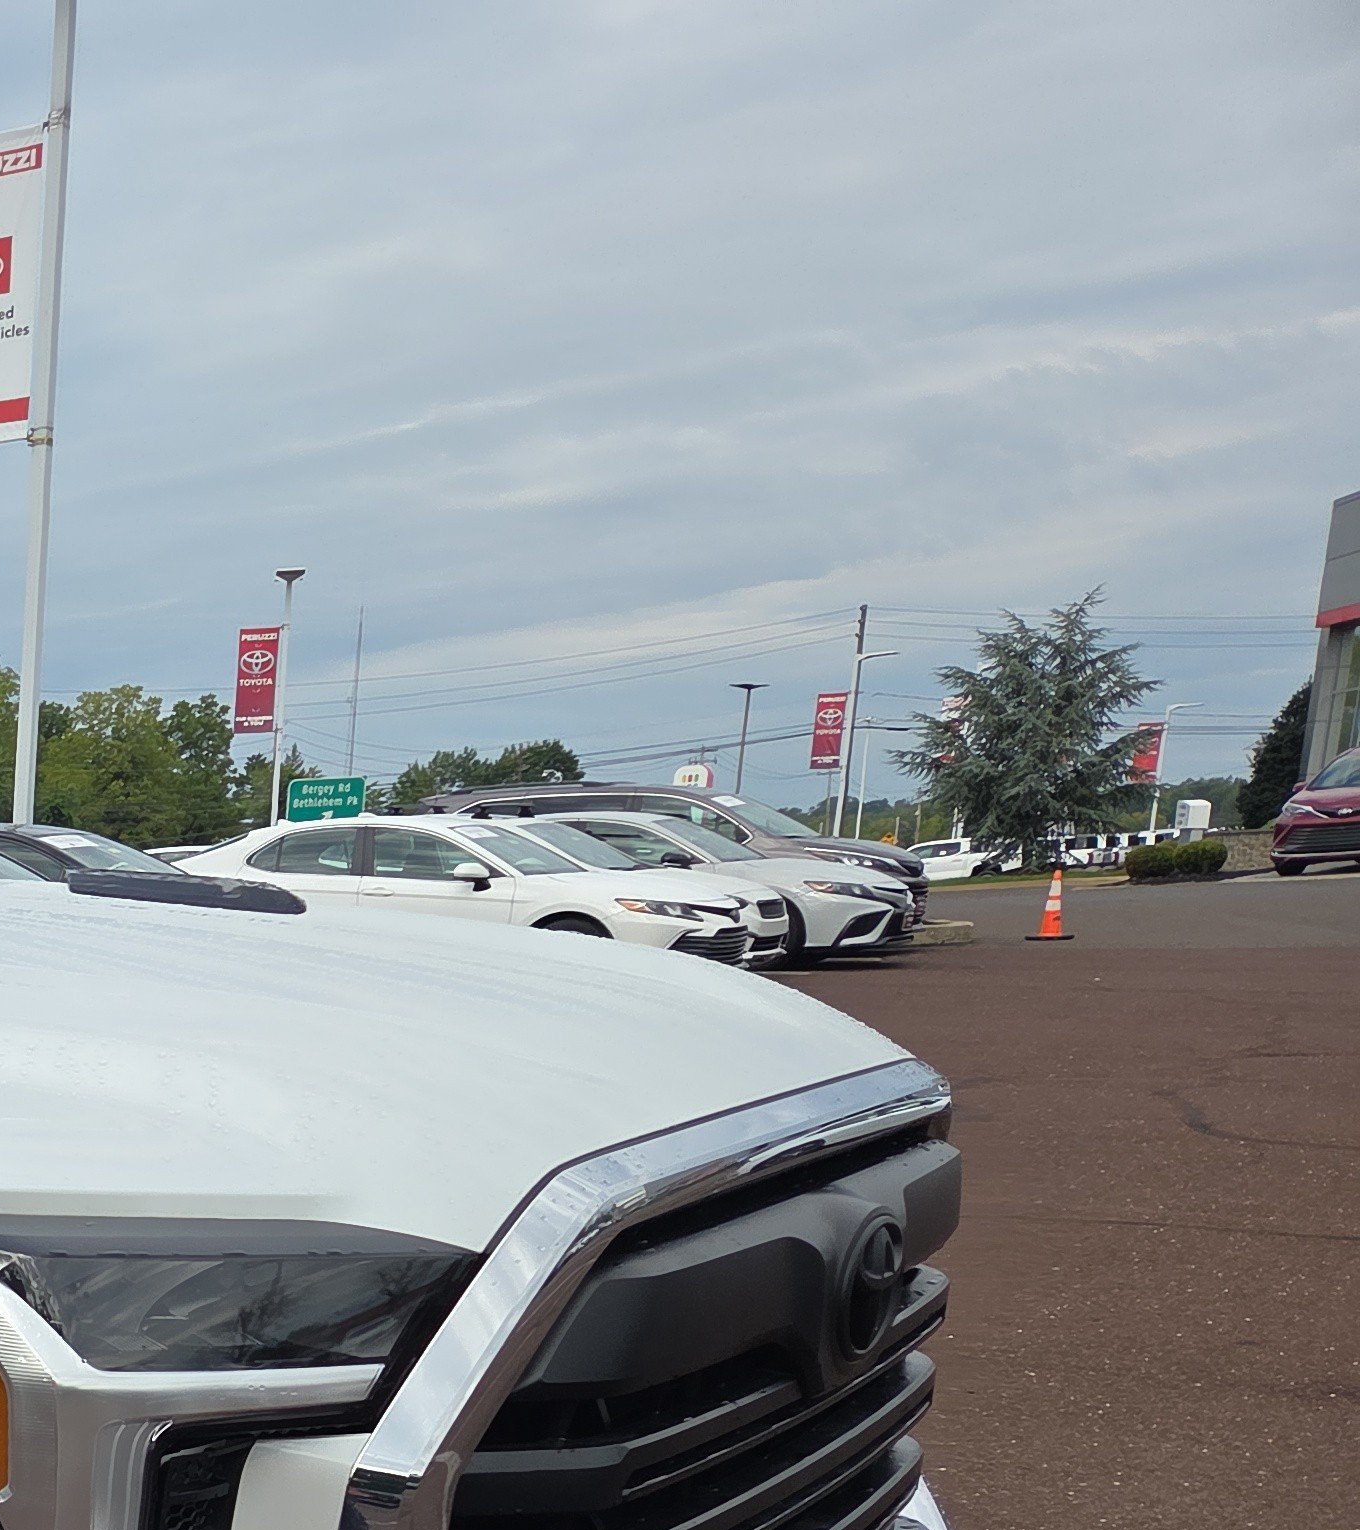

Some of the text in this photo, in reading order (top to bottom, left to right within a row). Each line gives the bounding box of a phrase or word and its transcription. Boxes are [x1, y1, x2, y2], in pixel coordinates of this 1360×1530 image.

[239, 678, 273, 686] TOYOTA
[301, 782, 351, 796] Bergey Rd
[292, 795, 359, 809] Bethlehem Pk
